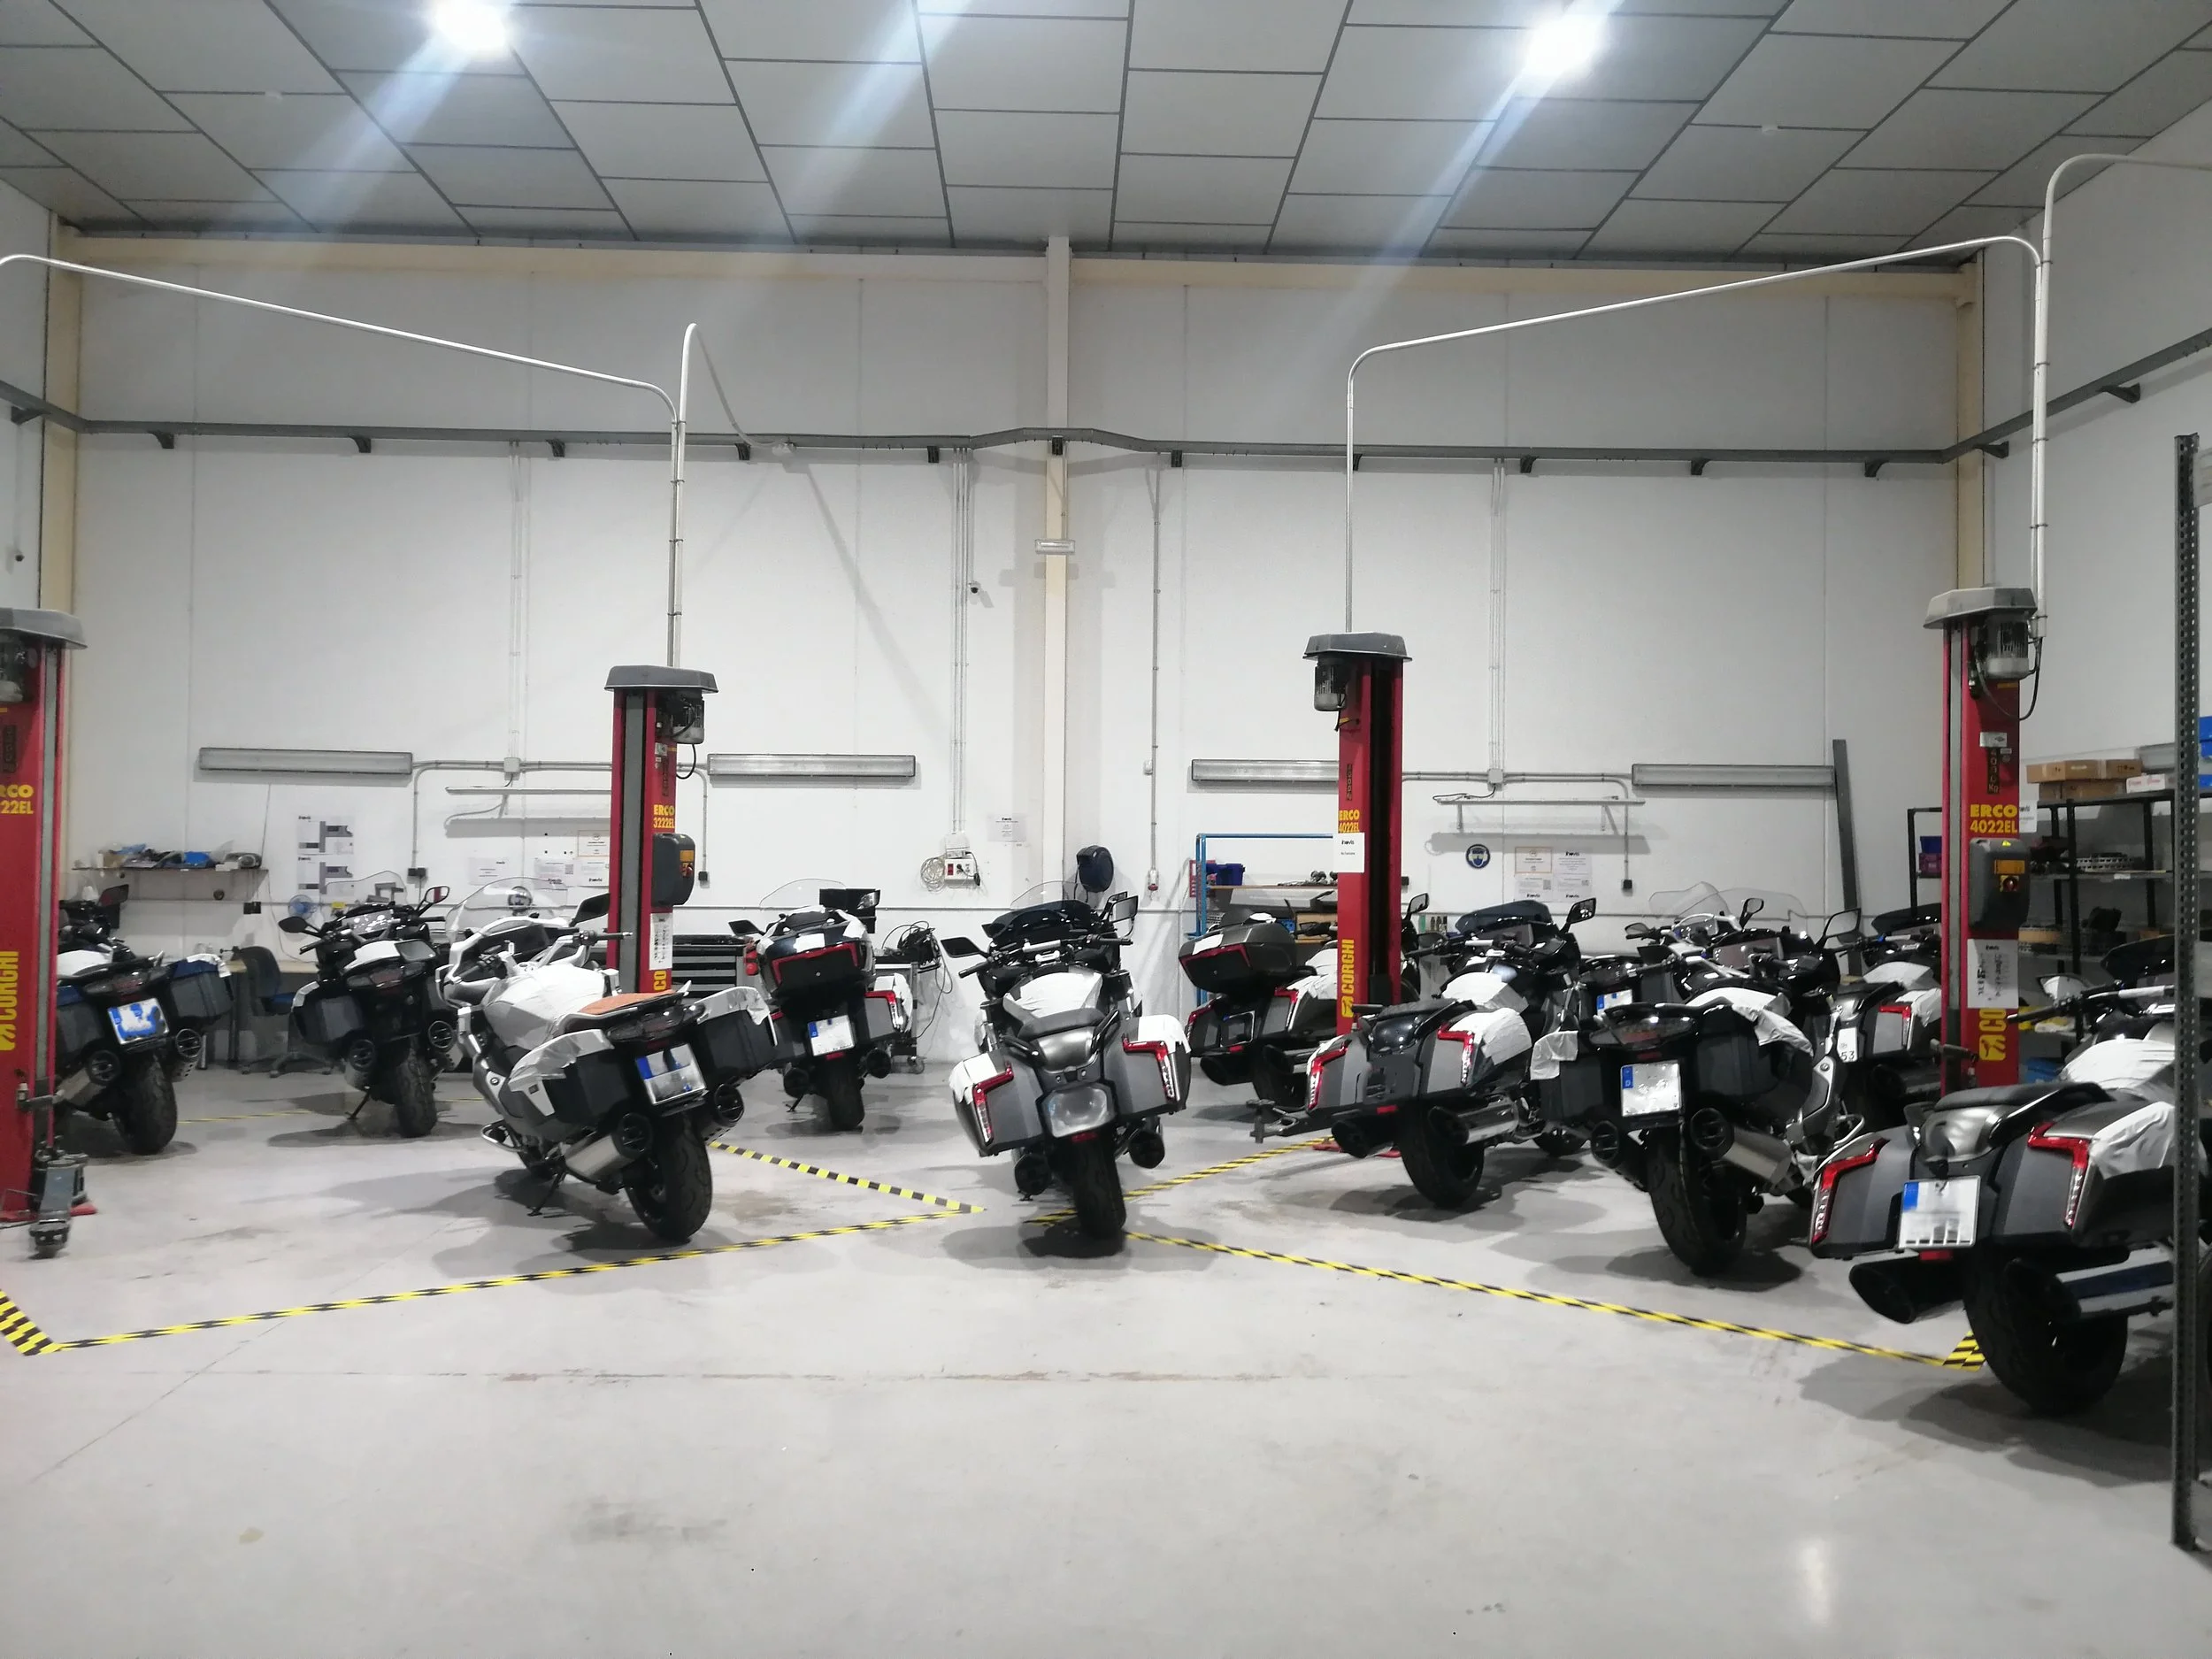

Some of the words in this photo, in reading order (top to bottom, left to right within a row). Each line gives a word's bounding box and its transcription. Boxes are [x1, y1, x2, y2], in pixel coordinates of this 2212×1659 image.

[0, 785, 34, 798] RCO
[0, 800, 34, 814] 22EL
[654, 805, 674, 815] ERCO
[1970, 804, 2017, 818] ERCO
[1339, 810, 1360, 821] ERCO
[654, 818, 675, 828] 3222EL
[1970, 820, 2017, 833] 4022EL
[1341, 939, 1355, 995] CORGHI
